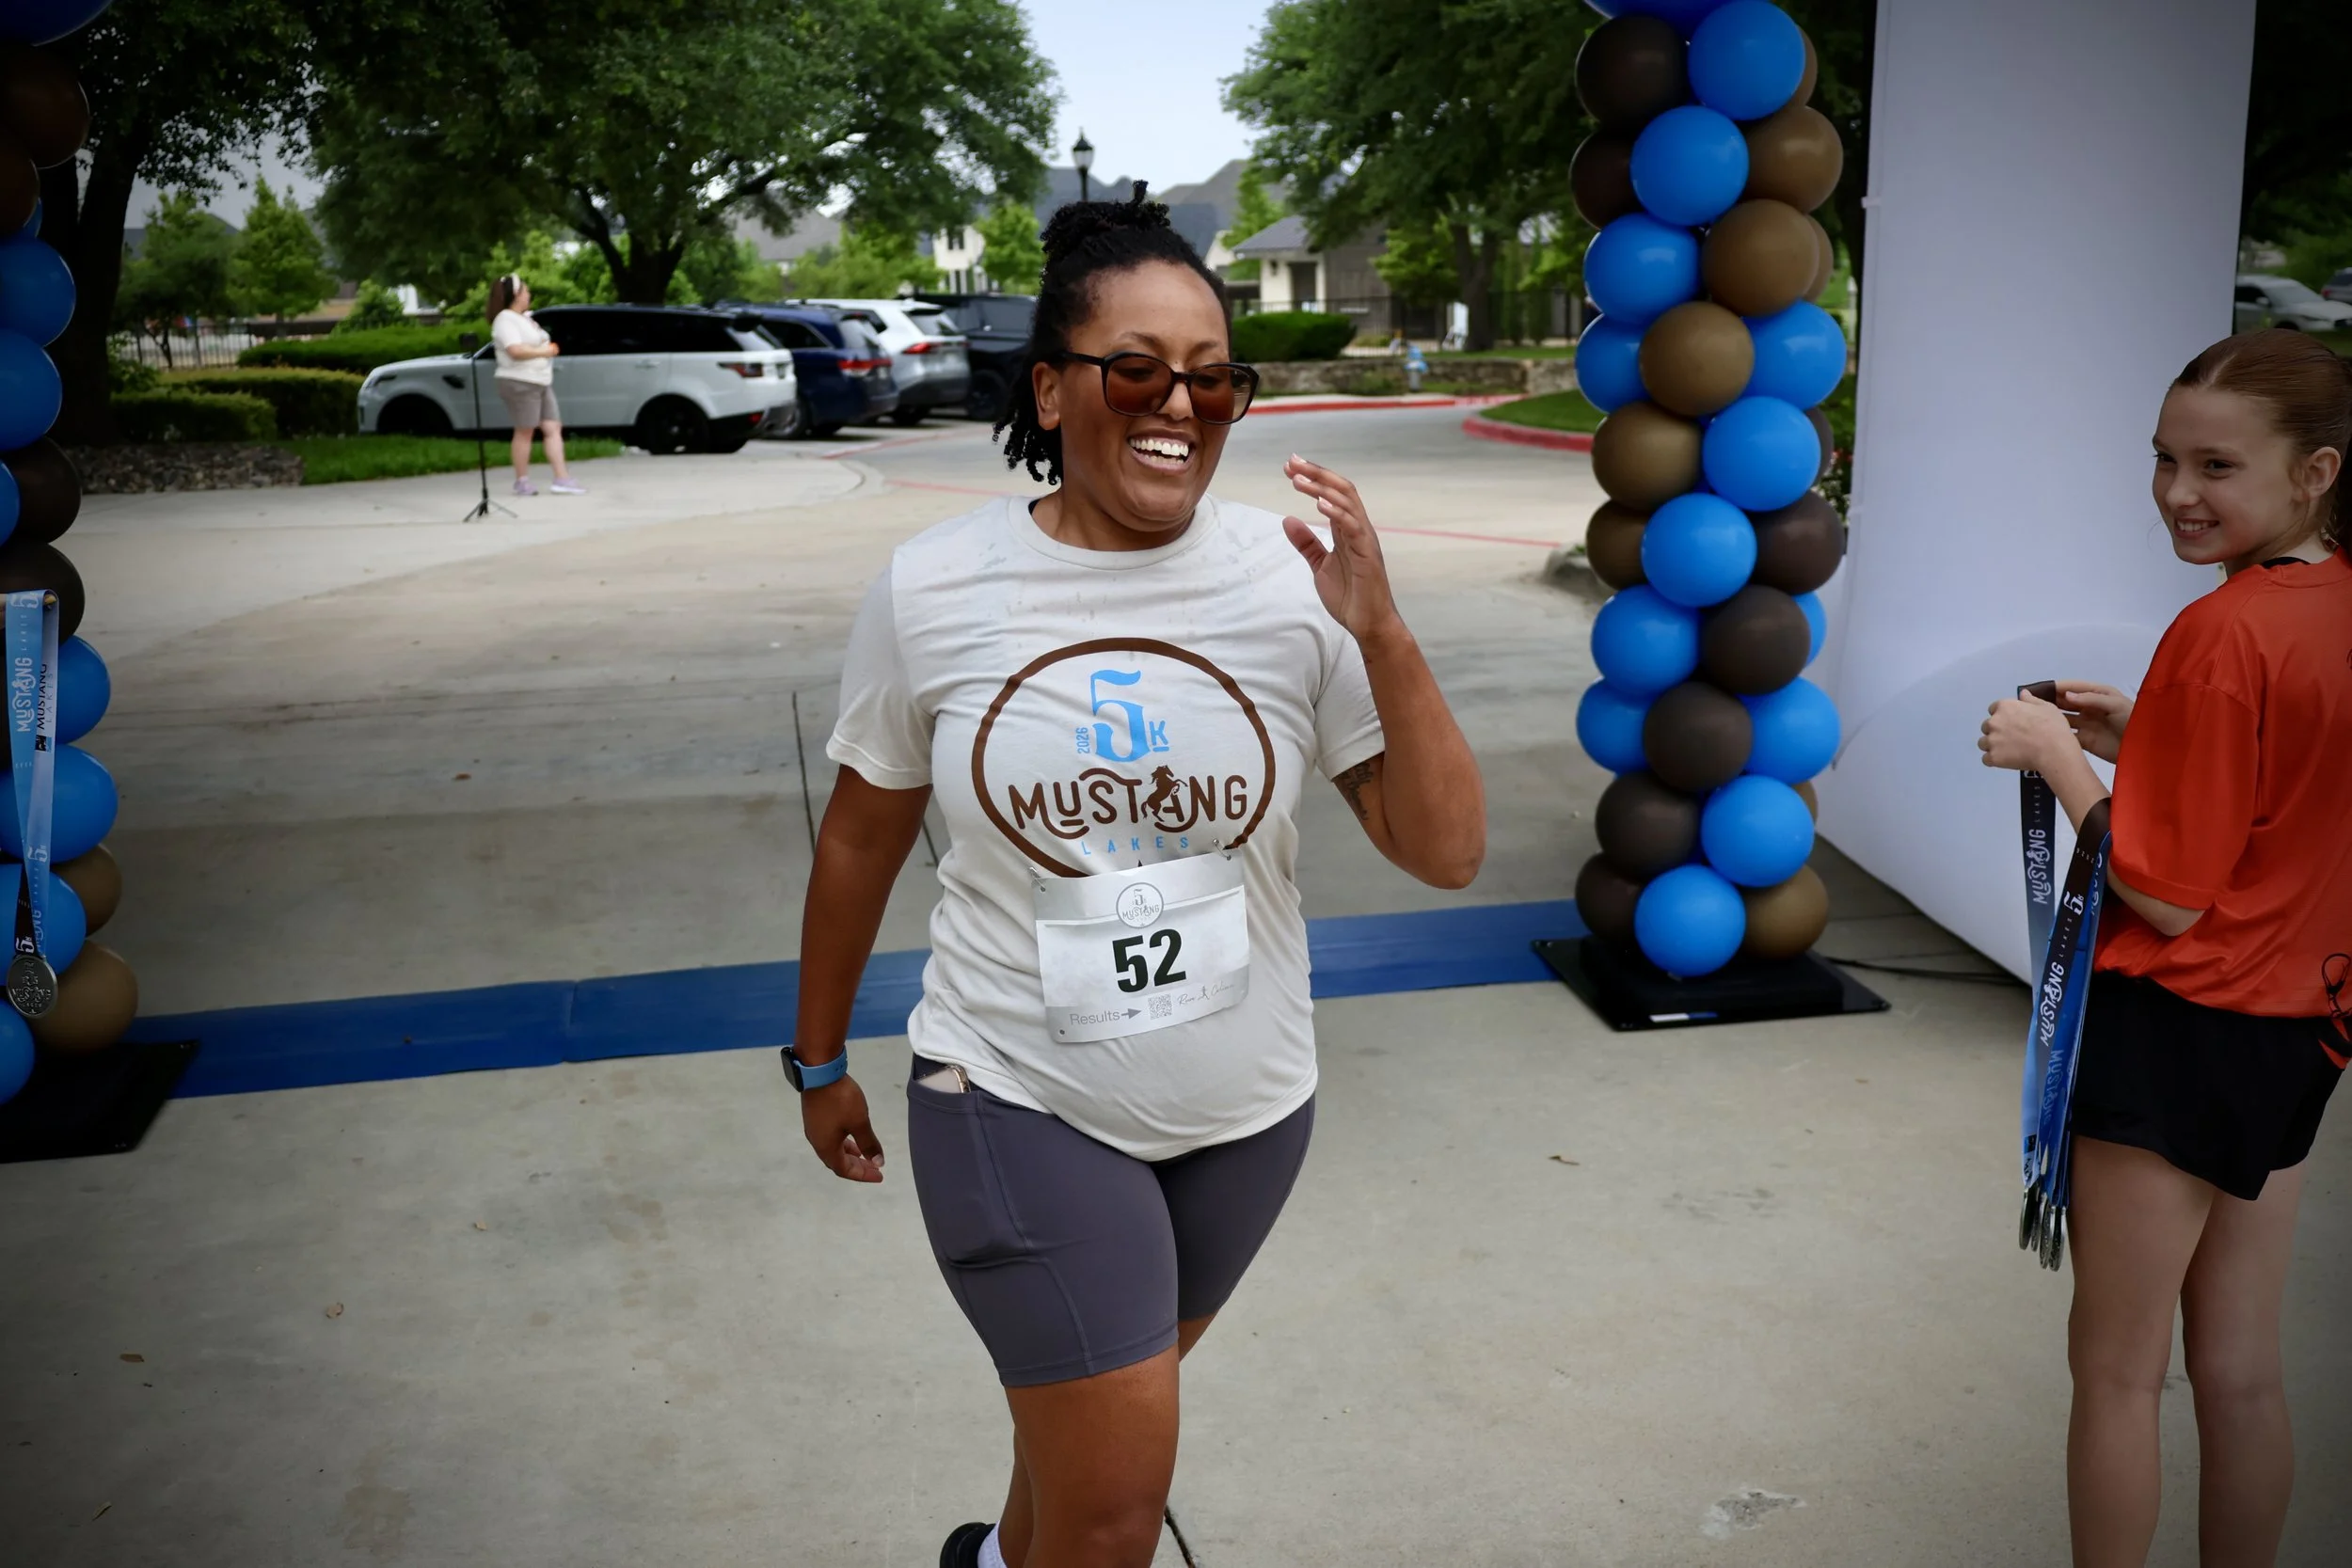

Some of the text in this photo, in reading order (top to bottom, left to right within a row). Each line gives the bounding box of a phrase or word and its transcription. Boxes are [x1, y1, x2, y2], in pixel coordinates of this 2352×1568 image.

[11, 657, 37, 732] MUSTANG
[1077, 726, 1089, 754] 2026
[1009, 768, 1248, 839] MUSTANG
[1082, 836, 1189, 855] LAKES
[2026, 829, 2052, 904] MUSTANG
[1121, 904, 1160, 921] MUSTANG
[1112, 928, 1187, 993] 52
[1070, 1009, 1120, 1026] Results
[2040, 961, 2065, 1047] MUSTANG
